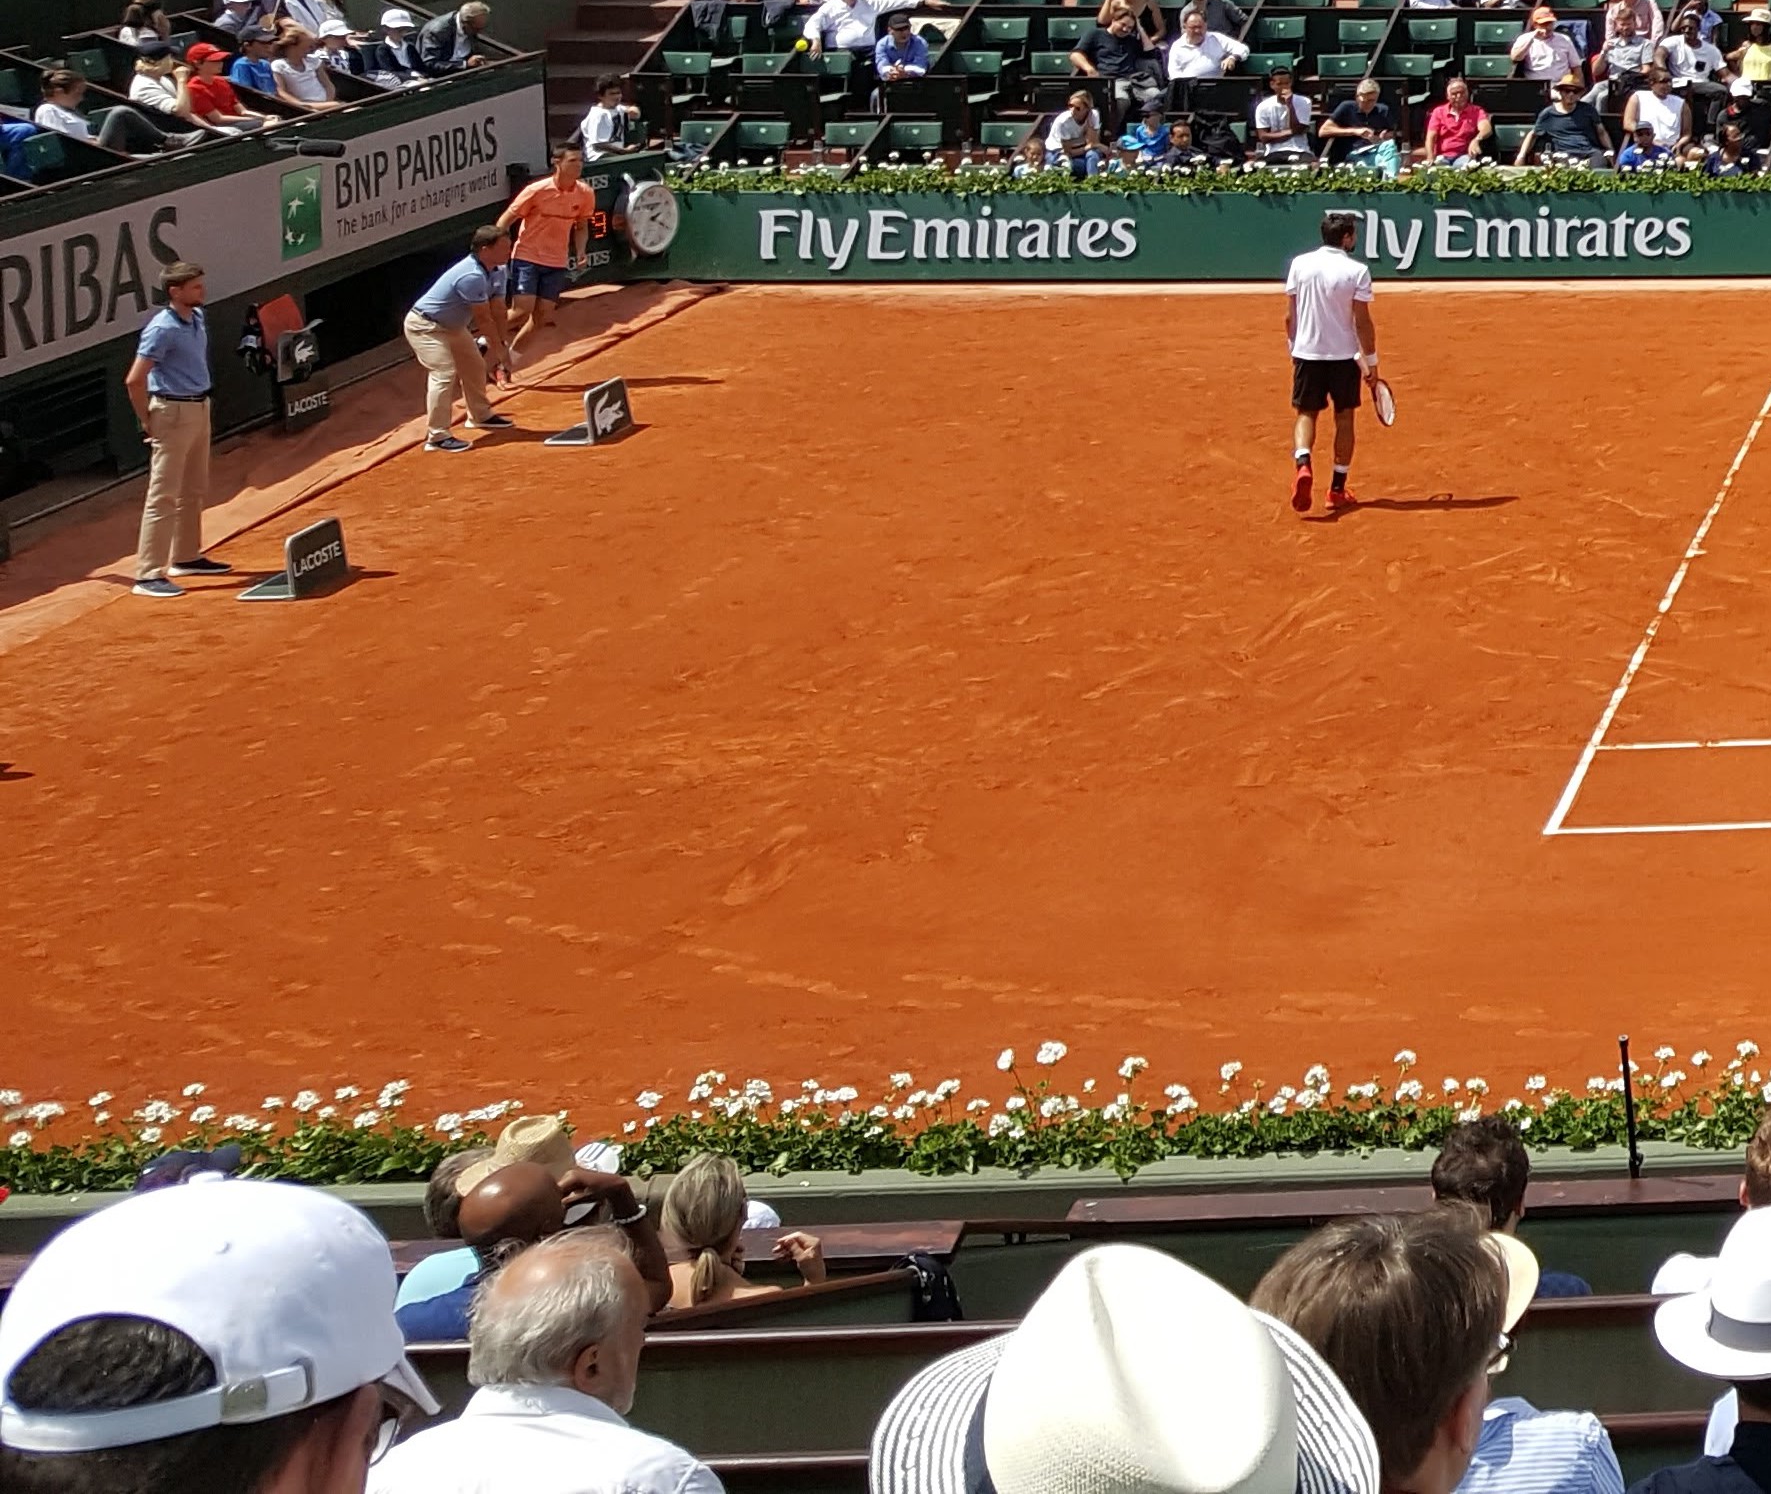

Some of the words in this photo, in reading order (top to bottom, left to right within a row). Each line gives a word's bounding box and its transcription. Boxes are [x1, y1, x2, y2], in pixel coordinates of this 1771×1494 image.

[335, 150, 389, 209] BNP
[396, 115, 498, 190] PARIBAS
[336, 217, 358, 238] The
[361, 207, 388, 231] bank
[390, 200, 407, 226] for
[410, 198, 417, 214] a
[420, 182, 466, 210] changing
[468, 168, 498, 193] world
[1434, 205, 1692, 259] Emirates
[758, 209, 860, 271] Fly
[866, 205, 1138, 260] Emirates
[287, 390, 330, 417] LACOSTE
[292, 539, 342, 578] LACOSTE
